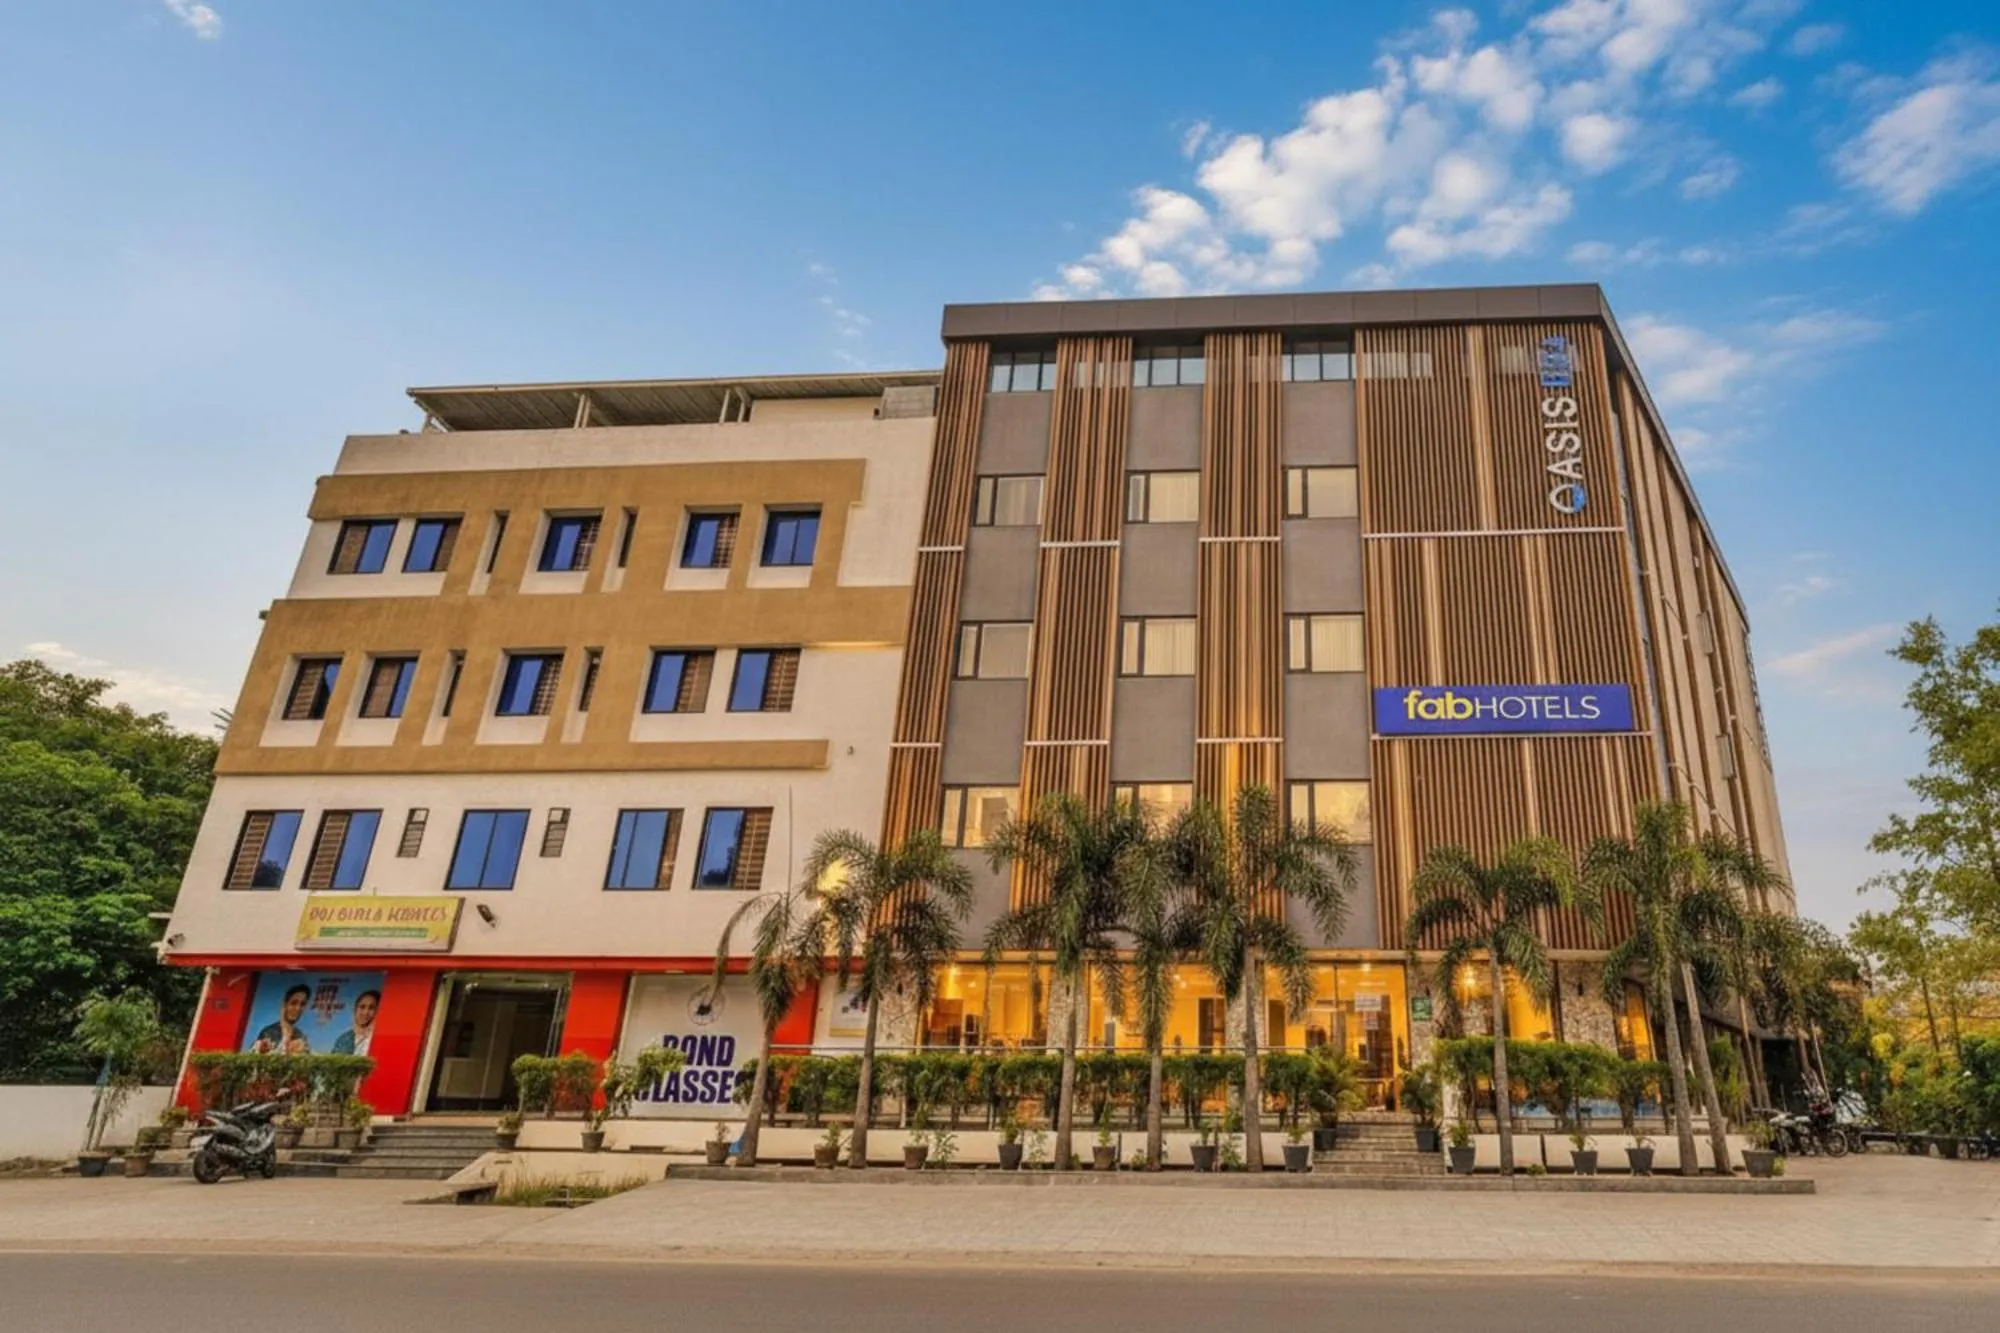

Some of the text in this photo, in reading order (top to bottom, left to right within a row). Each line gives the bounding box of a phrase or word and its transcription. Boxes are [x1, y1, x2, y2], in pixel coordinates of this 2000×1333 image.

[1541, 396, 1587, 514] OASIS
[1403, 690, 1601, 720] fabHOTELS
[635, 1070, 747, 1104] LASSE
